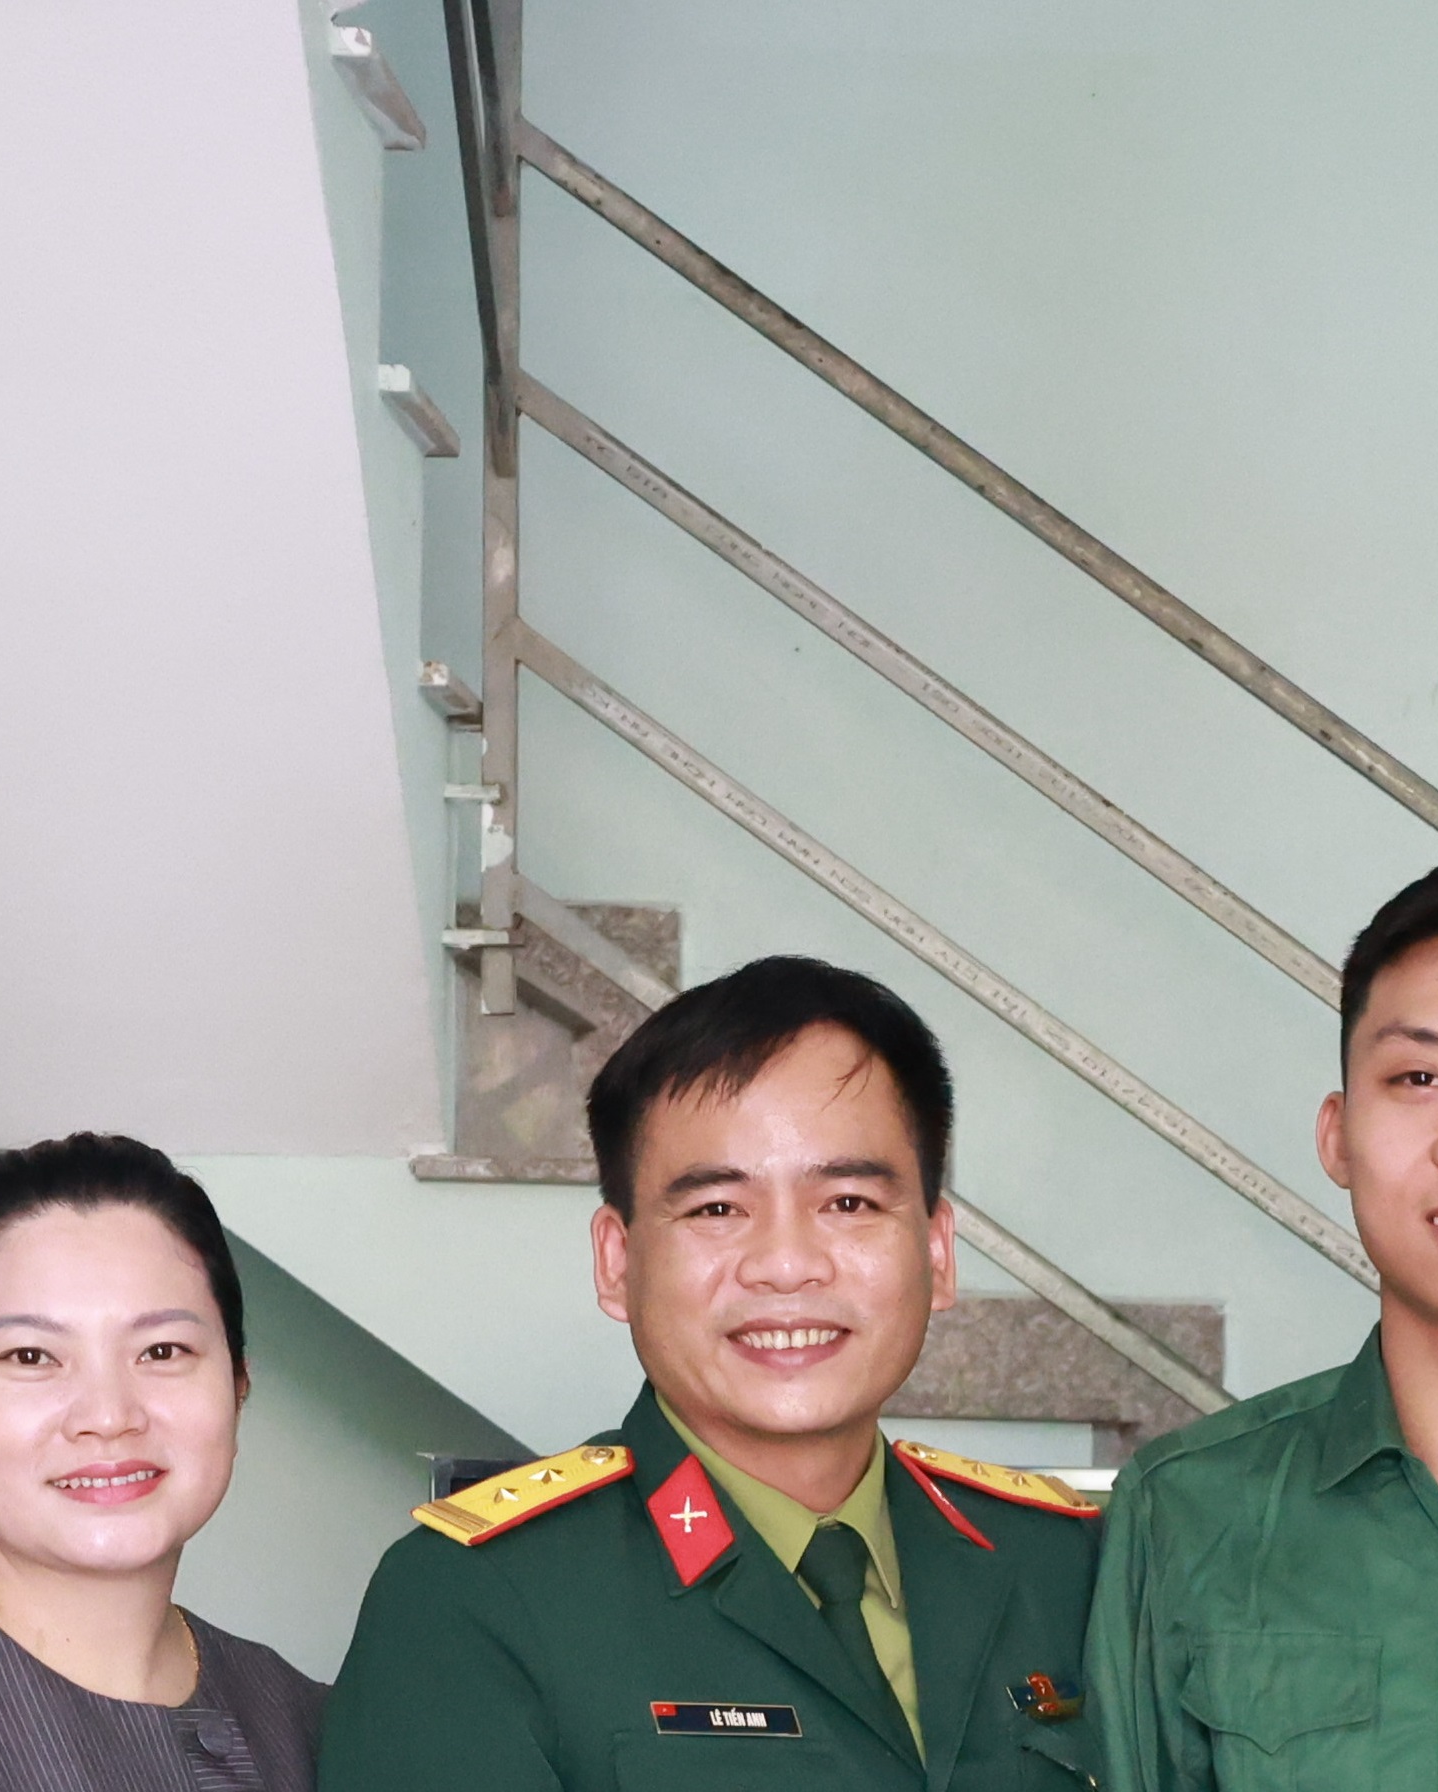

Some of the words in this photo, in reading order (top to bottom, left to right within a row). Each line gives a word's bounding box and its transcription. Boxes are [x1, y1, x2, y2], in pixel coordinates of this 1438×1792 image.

[710, 1708, 724, 1726] LÊ
[722, 1707, 747, 1728] TIẾN
[746, 1712, 768, 1728] ANH
